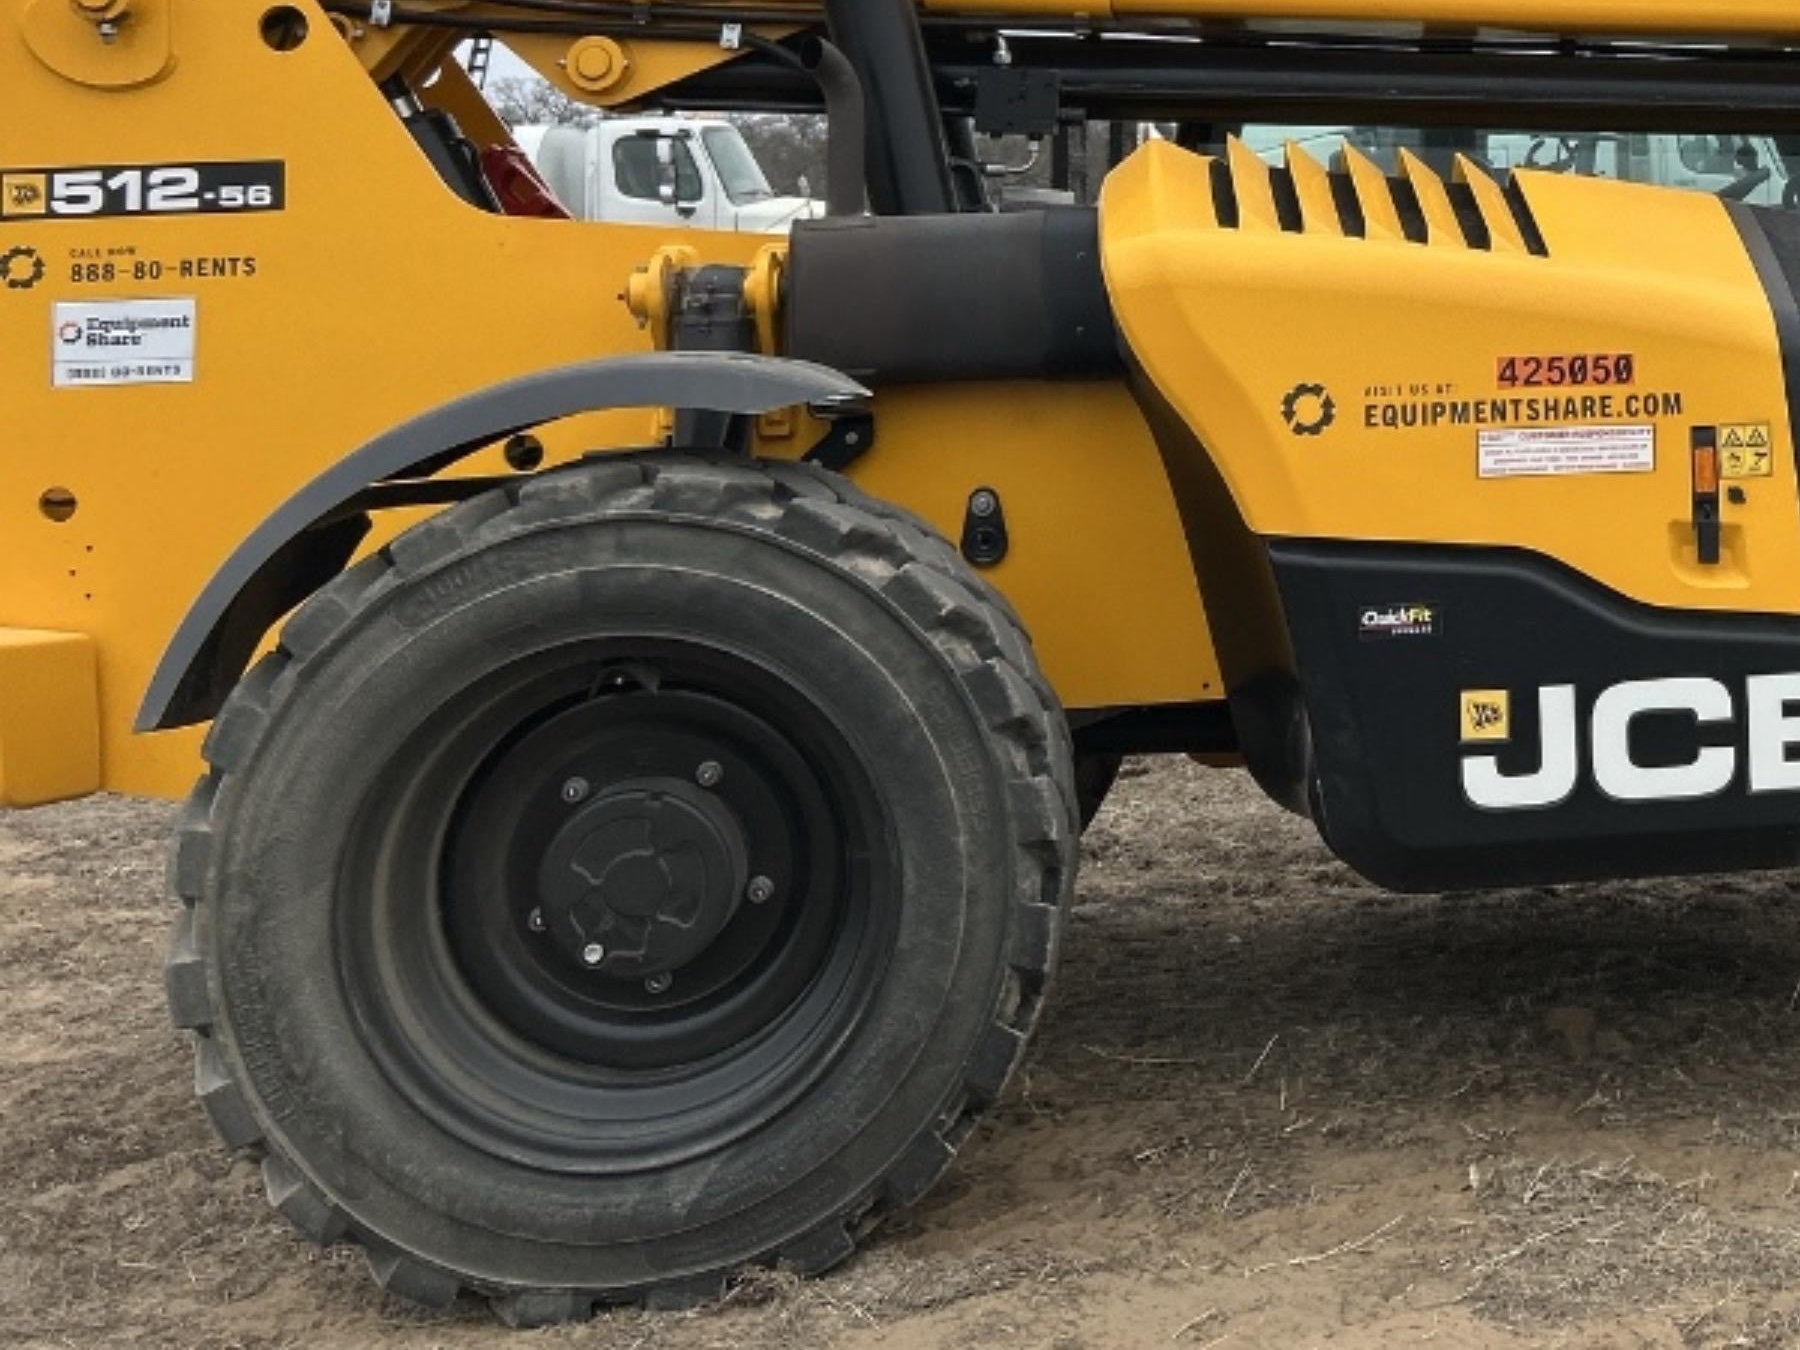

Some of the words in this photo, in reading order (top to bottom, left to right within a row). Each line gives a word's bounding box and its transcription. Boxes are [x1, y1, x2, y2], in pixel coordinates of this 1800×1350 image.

[71, 256, 257, 282] 888-80-RENTS
[1498, 353, 1634, 386] 425050
[1364, 392, 1682, 429] EQUIPMENTSHARE.COM
